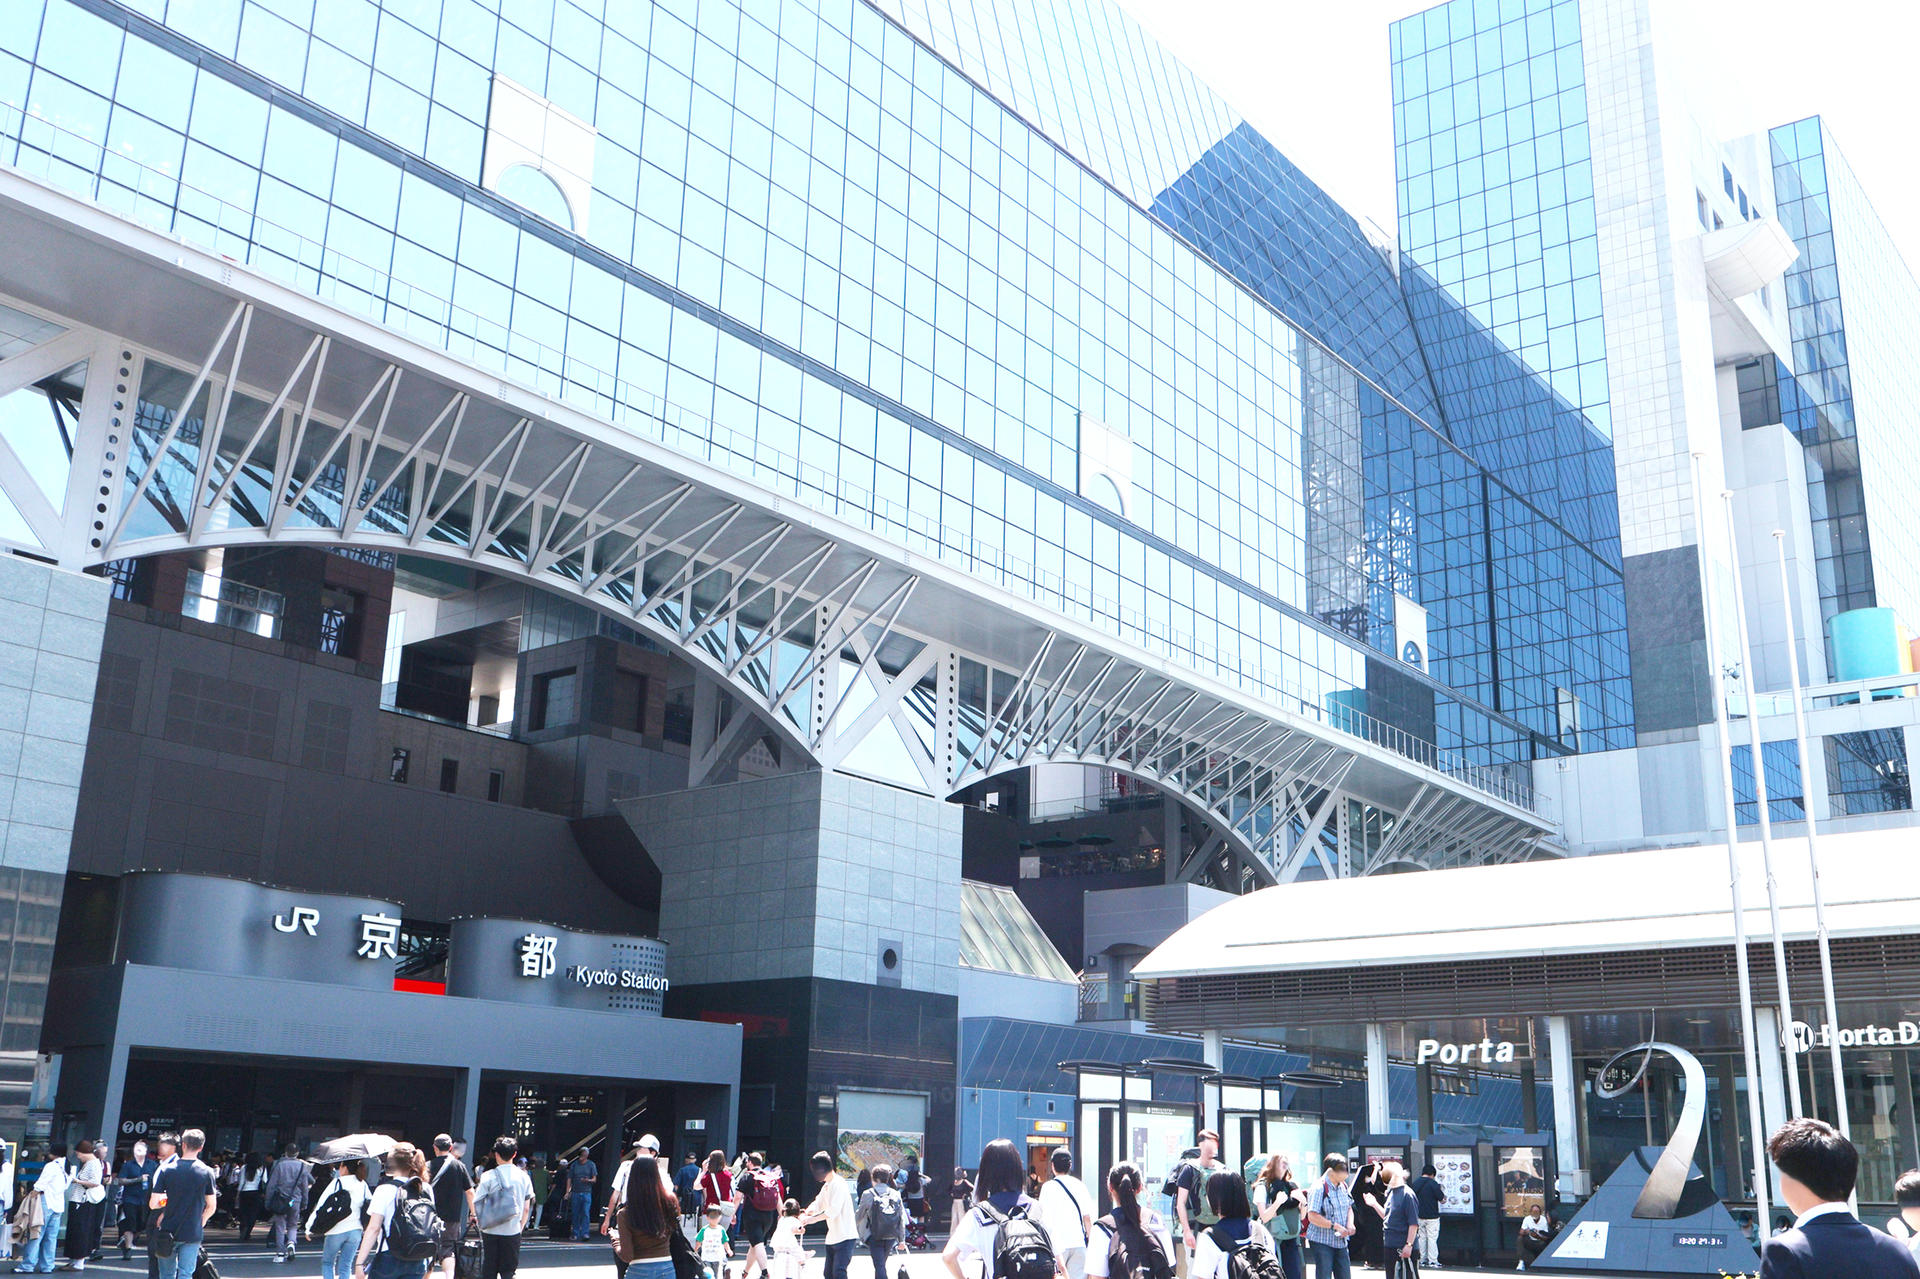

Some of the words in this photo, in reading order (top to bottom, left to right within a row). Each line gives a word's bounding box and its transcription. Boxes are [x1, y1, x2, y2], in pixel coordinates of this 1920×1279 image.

[274, 906, 320, 936] JR
[576, 965, 617, 988] Kyoto
[620, 970, 669, 991] Station
[1417, 1038, 1514, 1065] Porta
